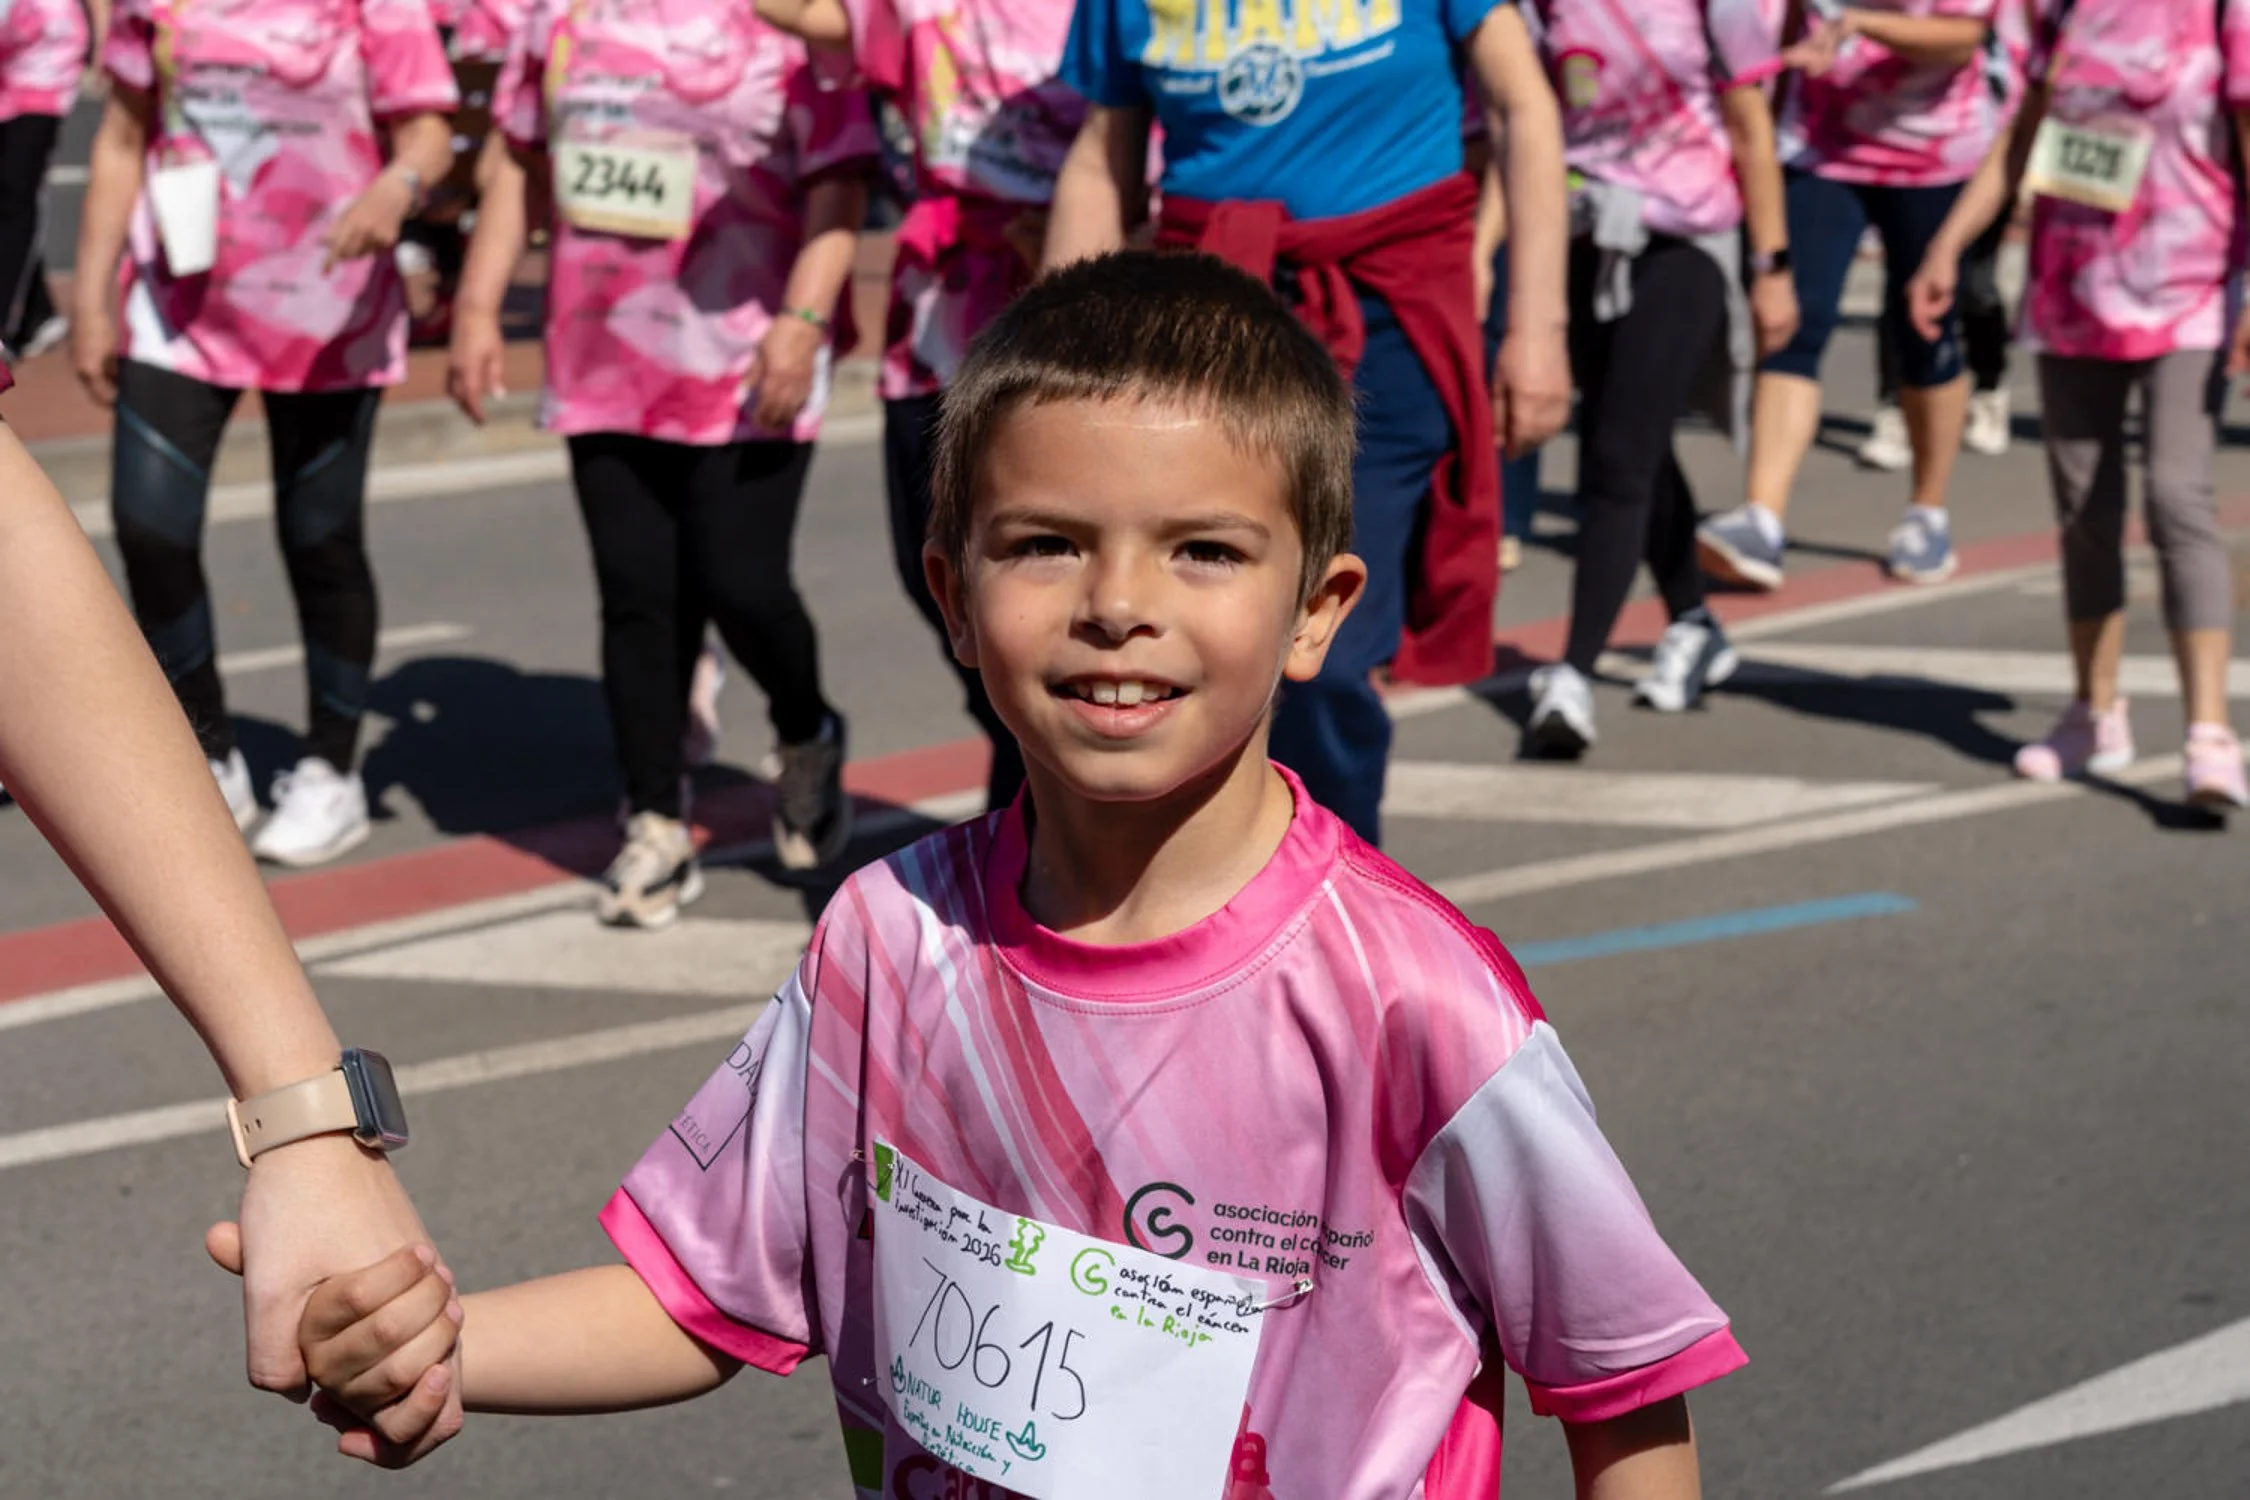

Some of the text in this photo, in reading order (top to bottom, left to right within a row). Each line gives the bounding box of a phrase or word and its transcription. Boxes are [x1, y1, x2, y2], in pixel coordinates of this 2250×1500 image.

[572, 152, 666, 204] 2344
[1213, 1202, 1319, 1229] asociación
[960, 1234, 1001, 1267] 2026
[1209, 1226, 1275, 1250] contra
[1280, 1233, 1298, 1251] el
[1206, 1250, 1310, 1279] en La Rioja
[1175, 1303, 1193, 1317] el
[908, 1256, 1087, 1421] 70615
[1162, 1314, 1213, 1348] Rioja
[906, 1371, 1003, 1442] NATUR HOUSE
